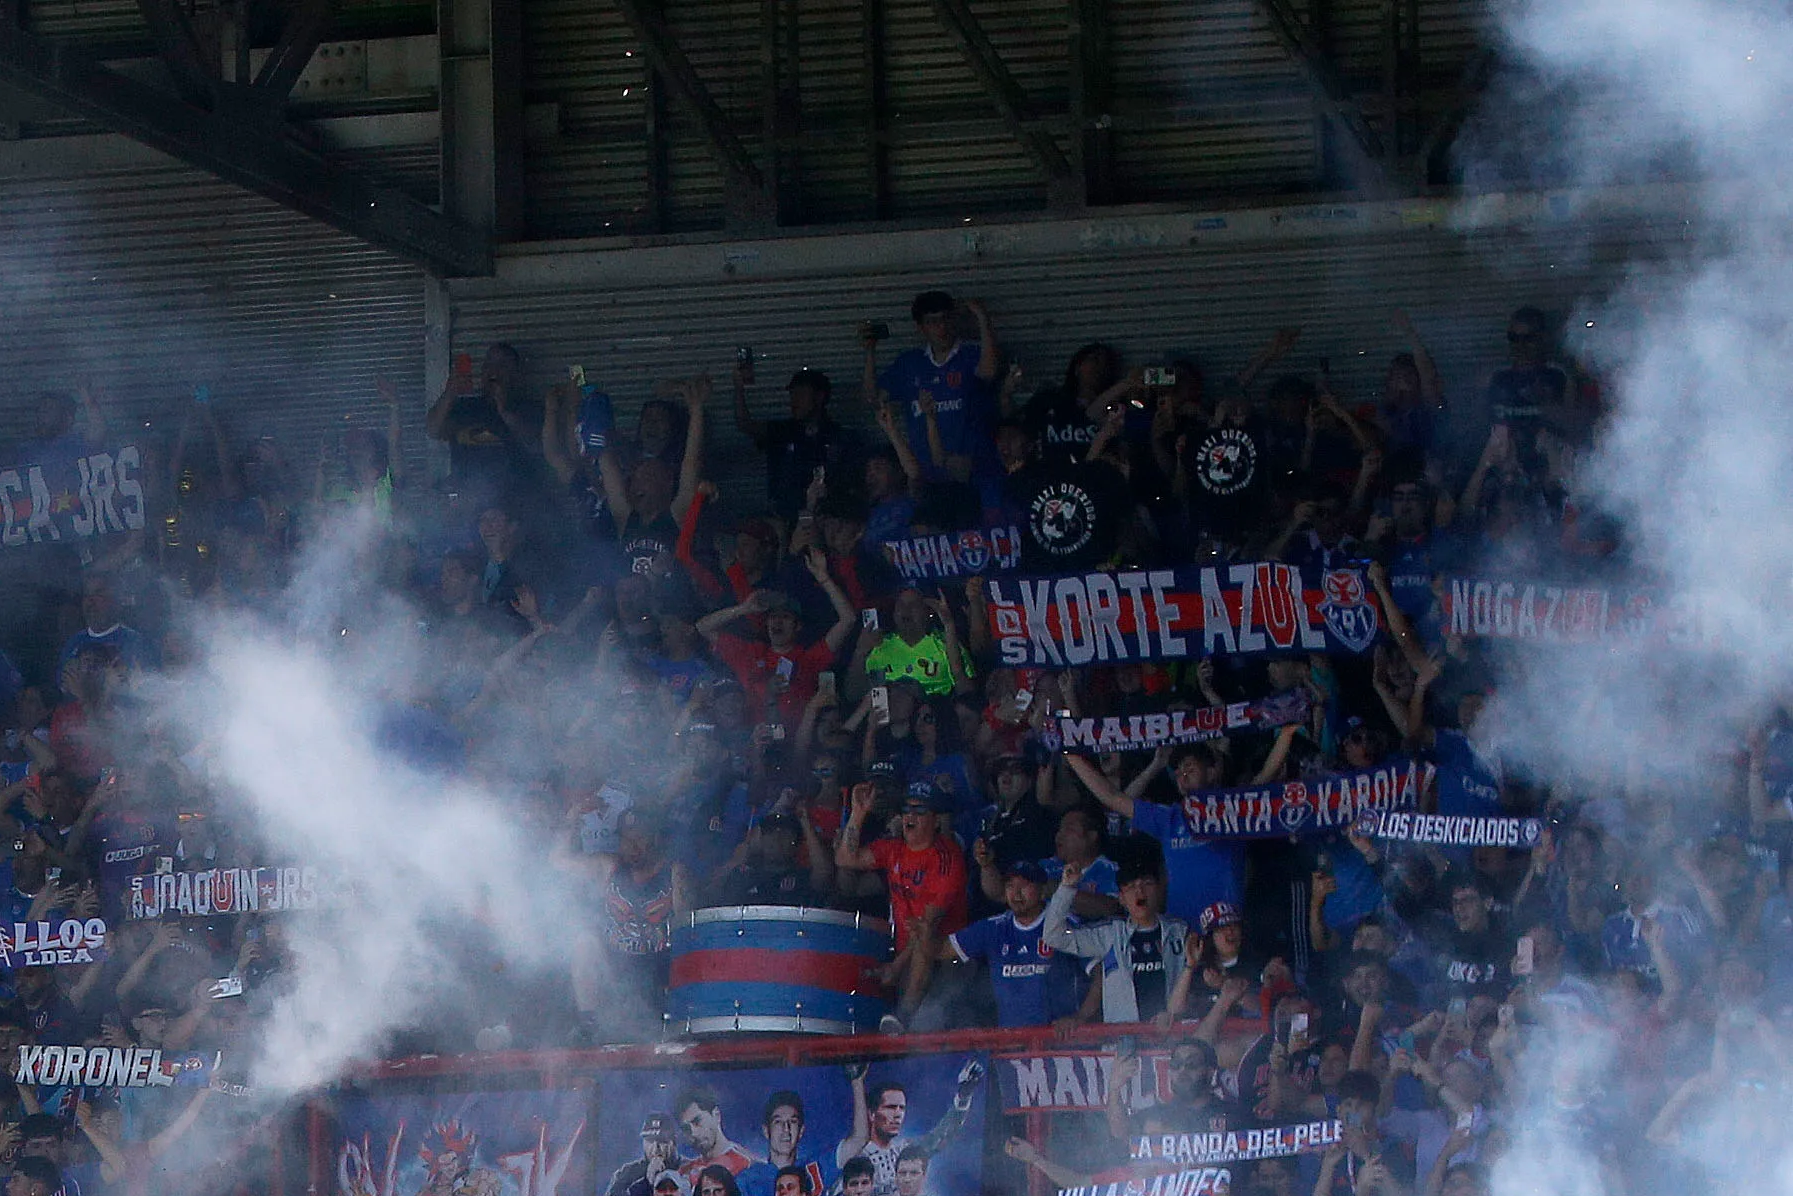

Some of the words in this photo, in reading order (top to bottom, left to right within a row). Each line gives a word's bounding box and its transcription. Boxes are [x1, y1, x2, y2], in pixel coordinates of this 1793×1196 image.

[71, 445, 146, 537] JRS
[885, 534, 960, 579] TAPIA
[989, 580, 1029, 664] LOS
[1019, 570, 1187, 666] KORTE
[1200, 562, 1326, 655] AZUL
[1060, 701, 1252, 748] MAIBLUE
[1183, 790, 1273, 835] SANTA
[1378, 814, 1409, 842] LOS
[145, 867, 259, 917] JOAQUIN
[23, 949, 94, 966] LDEA
[15, 1045, 175, 1087] KORONEL
[1161, 1130, 1239, 1162] BANDA
[1246, 1127, 1286, 1154] DEL
